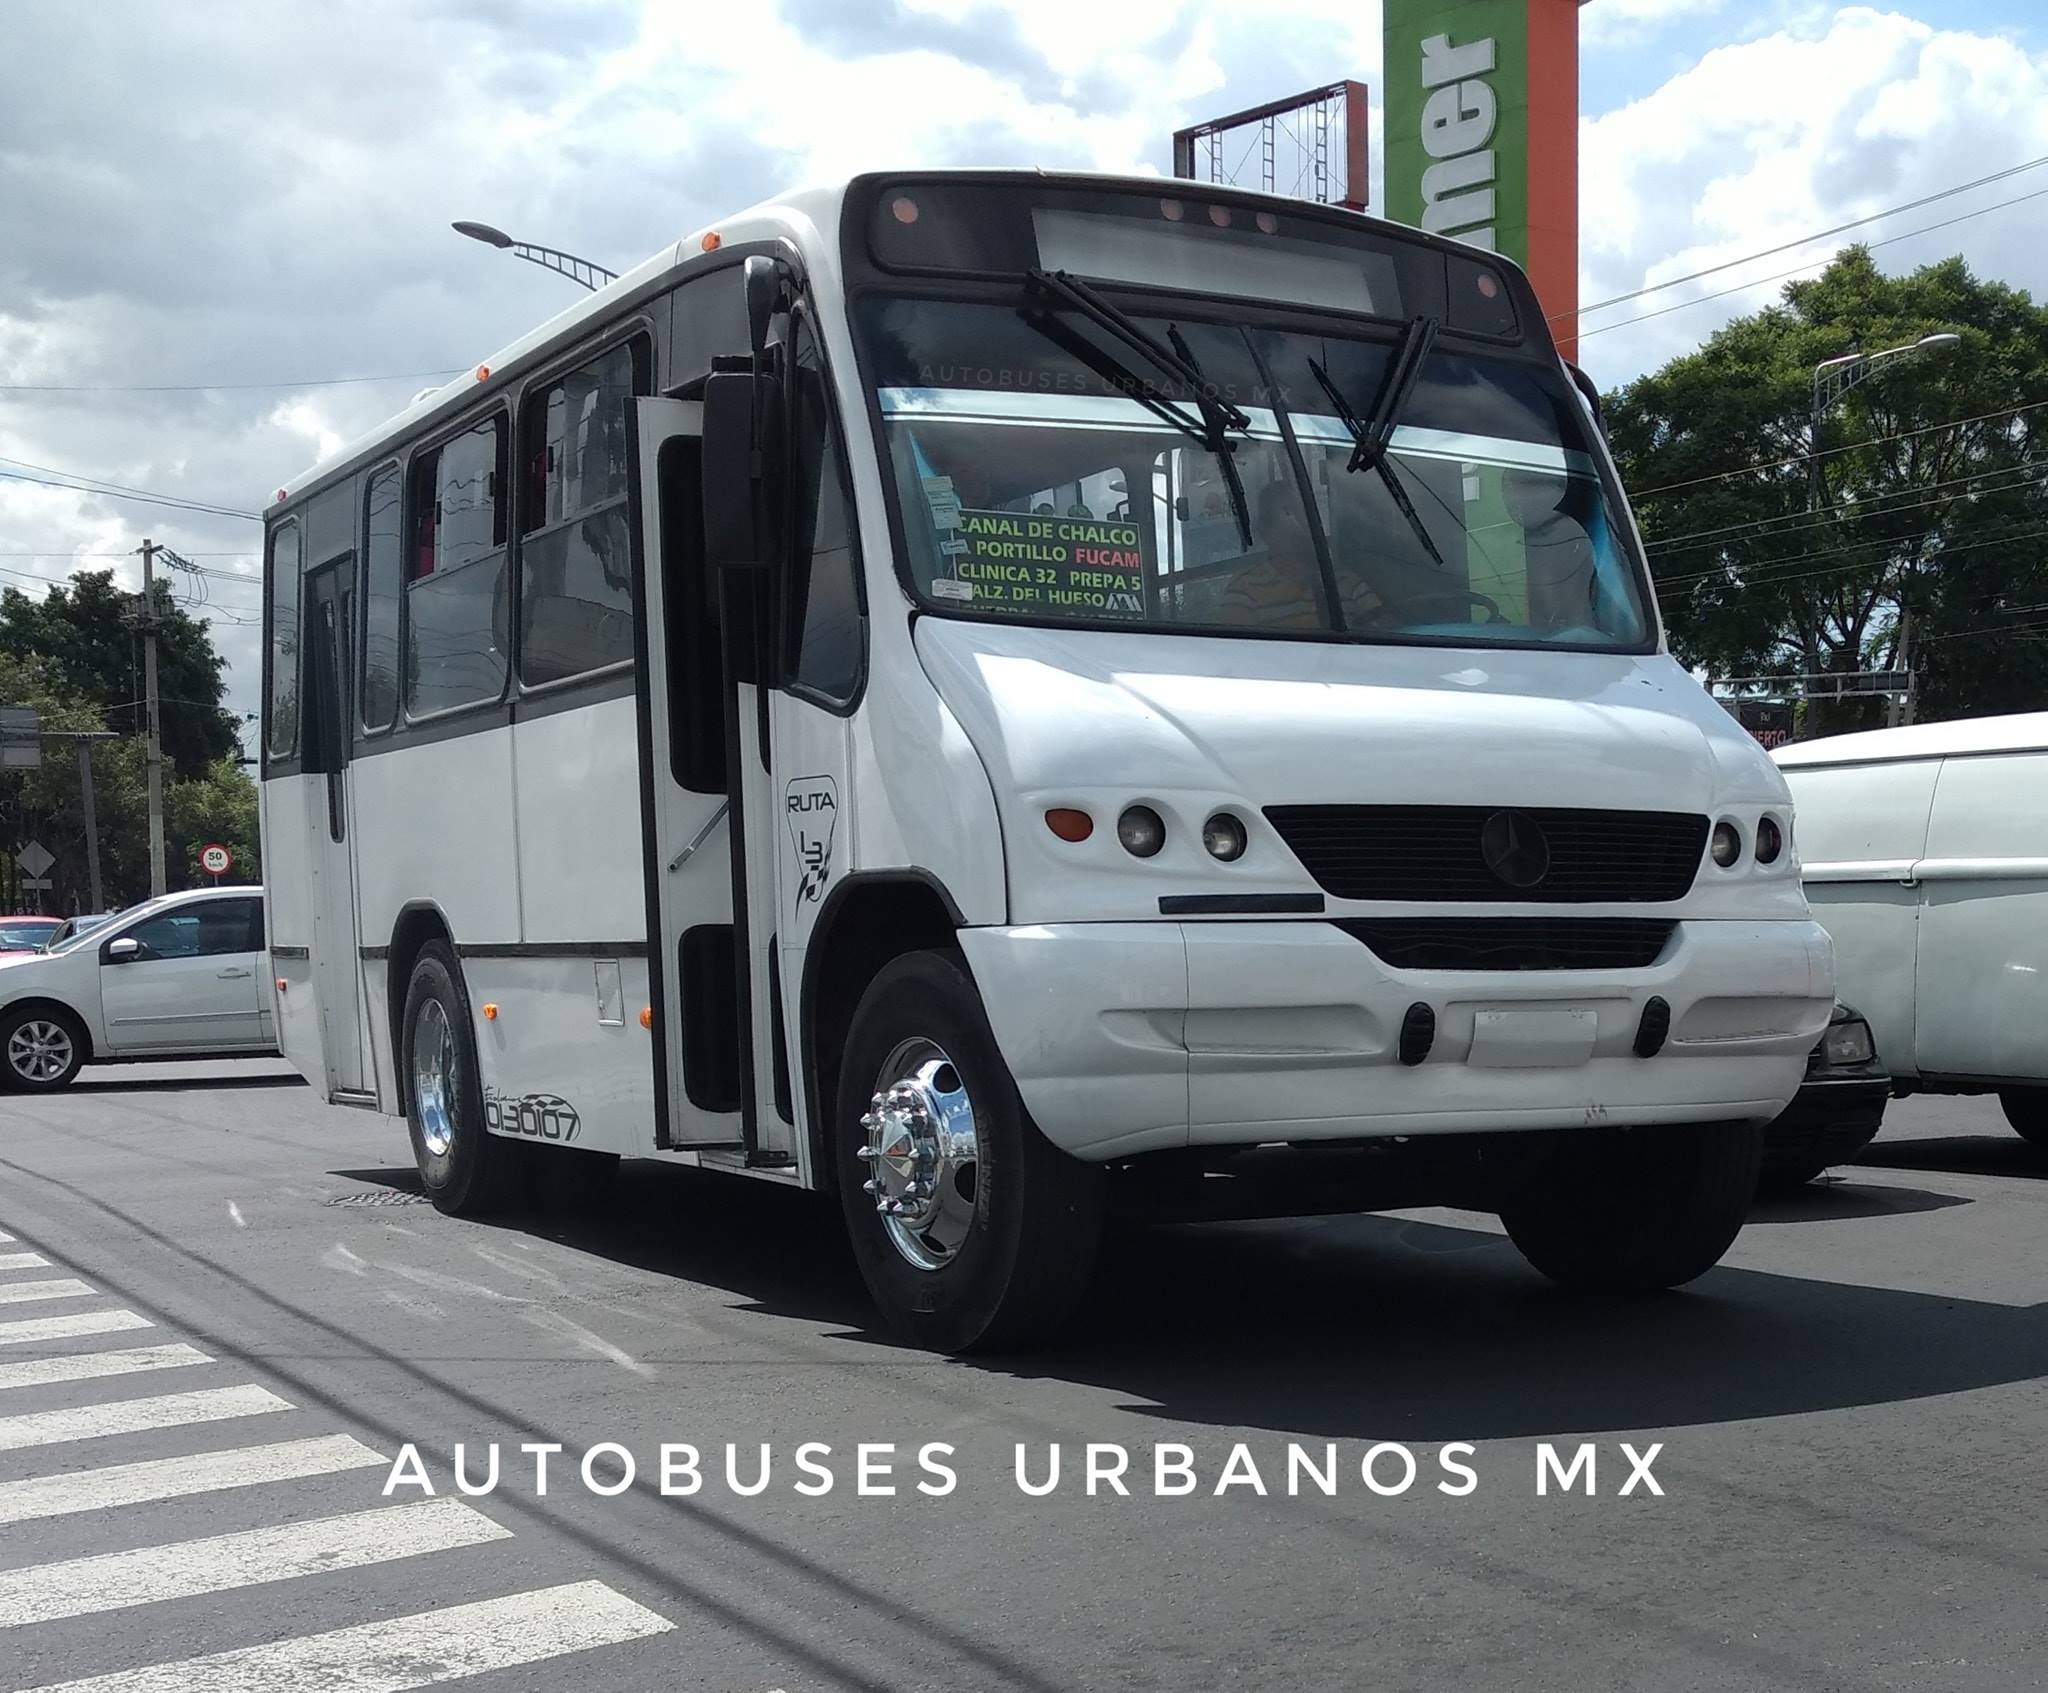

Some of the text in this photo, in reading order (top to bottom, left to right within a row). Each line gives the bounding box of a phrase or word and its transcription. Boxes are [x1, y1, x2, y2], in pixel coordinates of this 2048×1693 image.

[1028, 521, 1053, 539] DE
[1058, 524, 1137, 546] CHALCO
[976, 541, 1067, 562] PORTILLO
[1075, 547, 1140, 568] FUCAM
[959, 563, 1142, 591] CLINICA 32 PREPA 5
[972, 584, 1009, 600] ALZ.
[1048, 590, 1105, 608] HUESO
[788, 792, 836, 814] RUTA
[208, 852, 222, 861] 50
